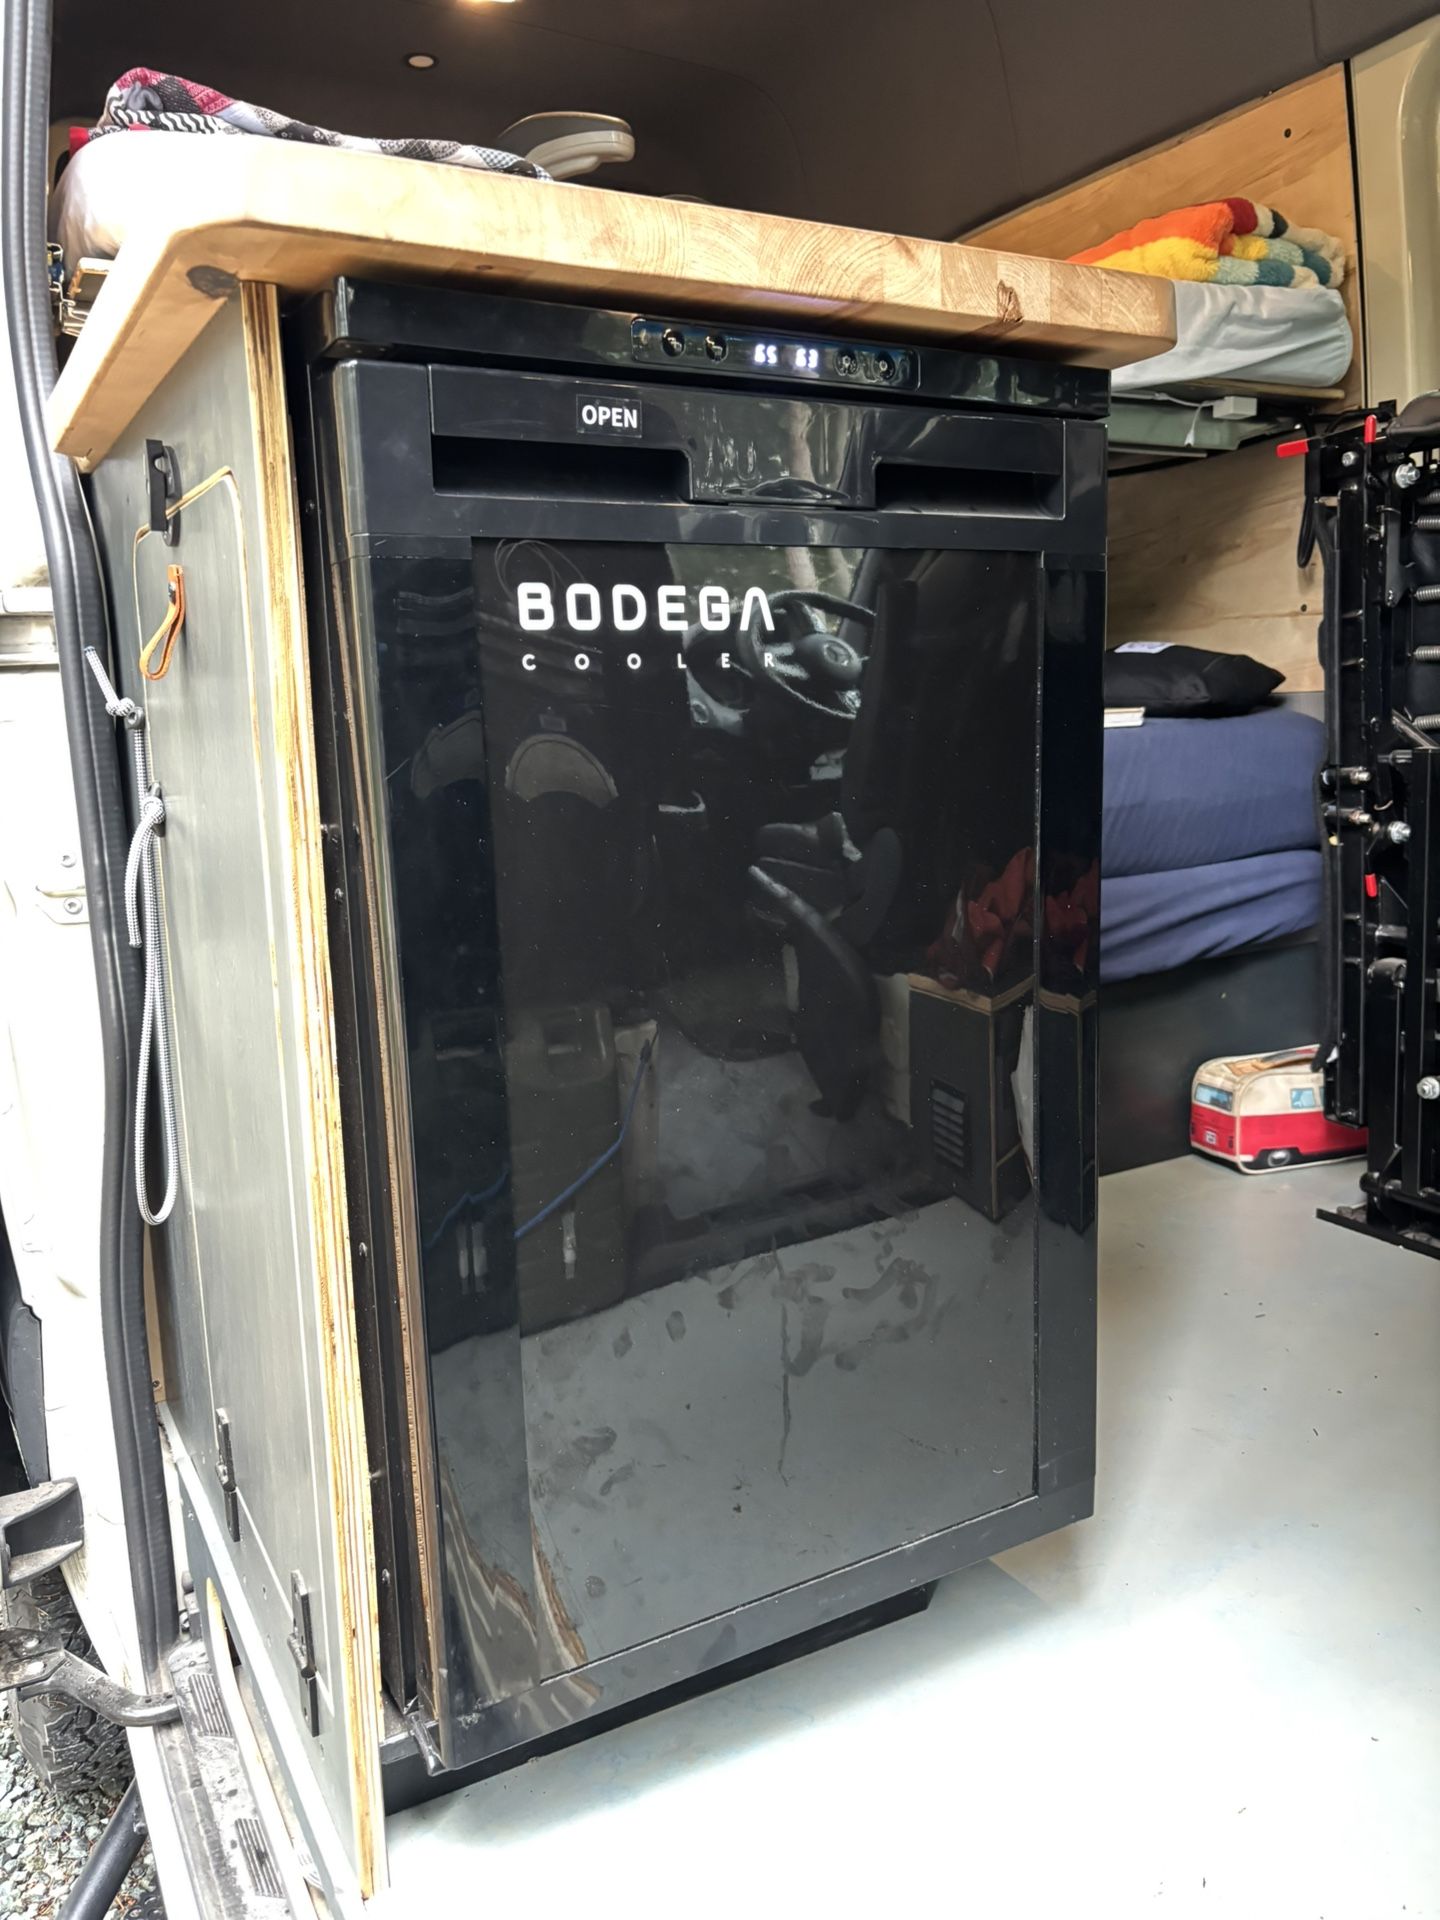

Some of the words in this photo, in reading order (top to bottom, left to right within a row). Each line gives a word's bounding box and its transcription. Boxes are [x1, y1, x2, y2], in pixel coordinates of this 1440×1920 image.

[753, 343, 778, 365] 65
[581, 404, 638, 429] OPEN
[517, 582, 775, 632] BODEGA
[521, 651, 775, 671] COOLER
